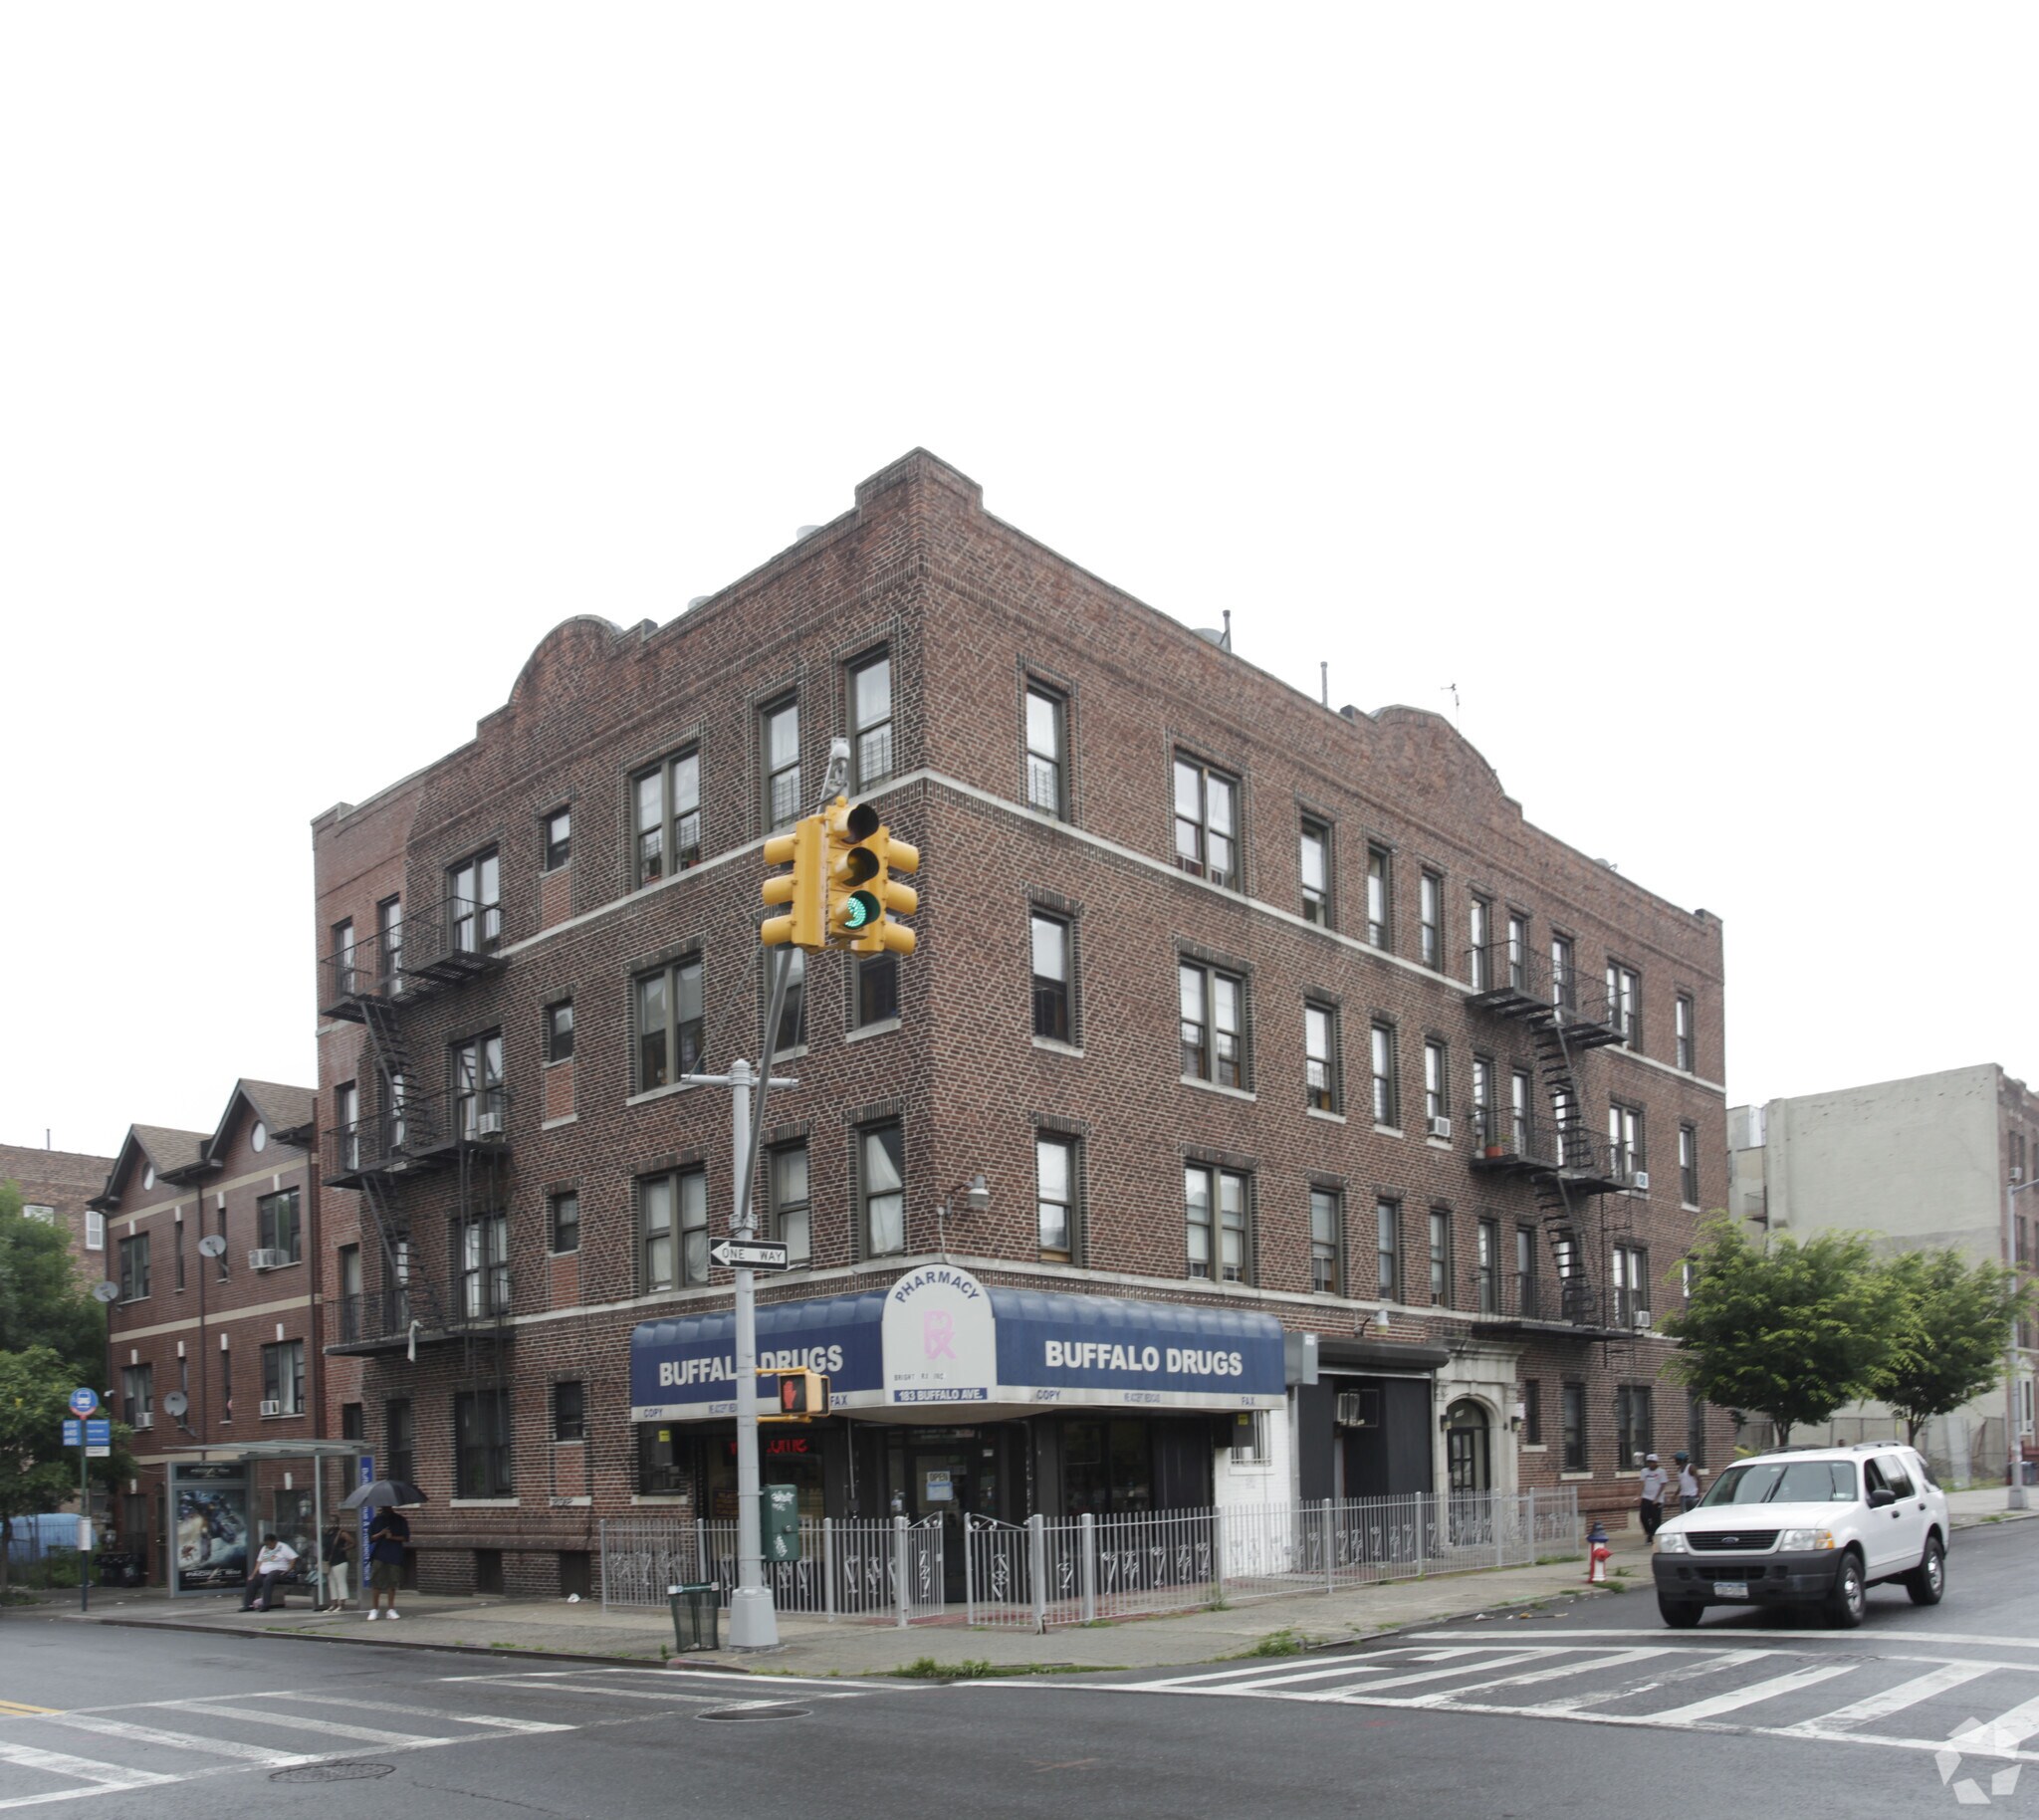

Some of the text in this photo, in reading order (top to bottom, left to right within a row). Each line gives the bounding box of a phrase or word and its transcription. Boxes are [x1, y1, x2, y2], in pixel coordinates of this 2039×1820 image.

[722, 1248, 783, 1262] ONE WAY
[894, 1270, 981, 1303] PHARMACY
[1045, 1340, 1244, 1376] BUFFALO DRUGS
[659, 1344, 843, 1387] BUFFAL DRUGS
[830, 1394, 848, 1407] FAX
[899, 1390, 916, 1402] 183
[917, 1389, 960, 1402] BUFFALO
[1035, 1389, 1061, 1401] COPY
[1242, 1396, 1256, 1407] FAX
[643, 1408, 663, 1419] COPY
